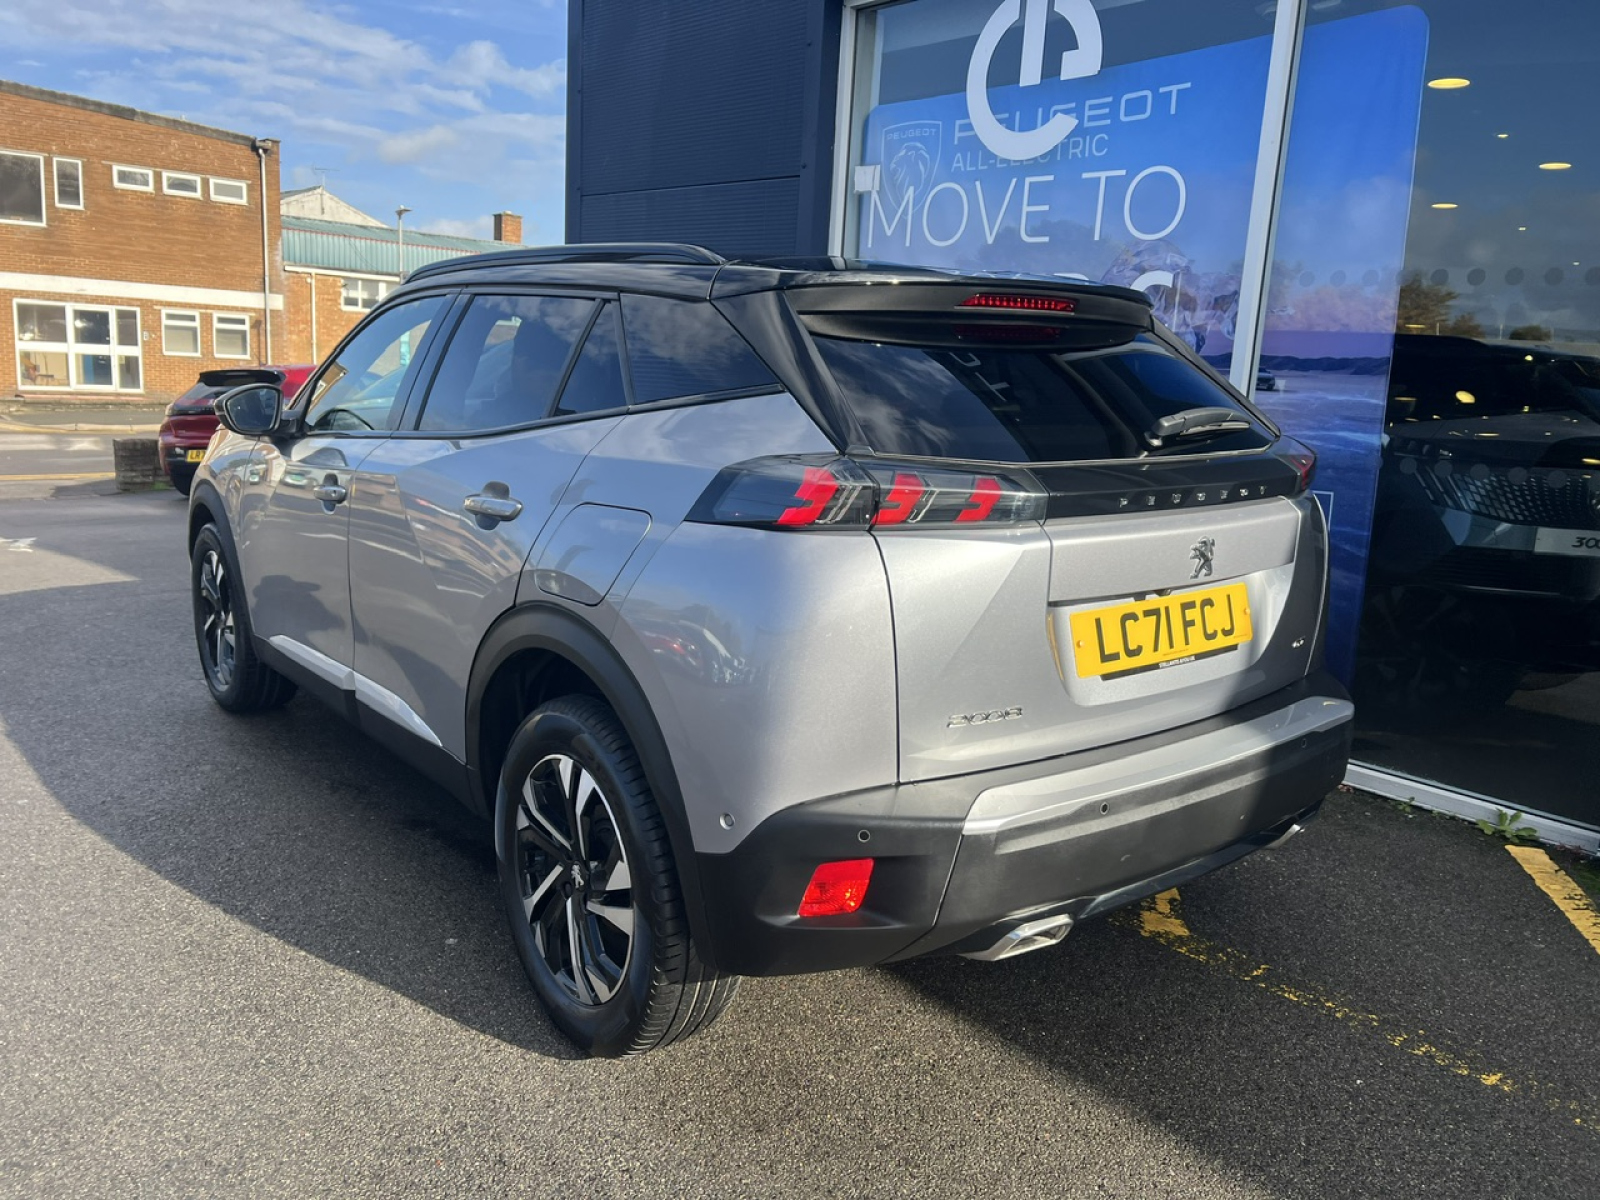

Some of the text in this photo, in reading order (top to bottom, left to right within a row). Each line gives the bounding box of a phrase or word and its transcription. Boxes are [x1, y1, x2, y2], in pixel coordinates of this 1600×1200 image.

[886, 128, 937, 140] PEUGEOT
[953, 82, 1191, 145] PUGEOT
[867, 164, 1187, 248] MOVE TO
[1094, 593, 1235, 664] LC71 FCJ
[946, 705, 1023, 728] 2008
